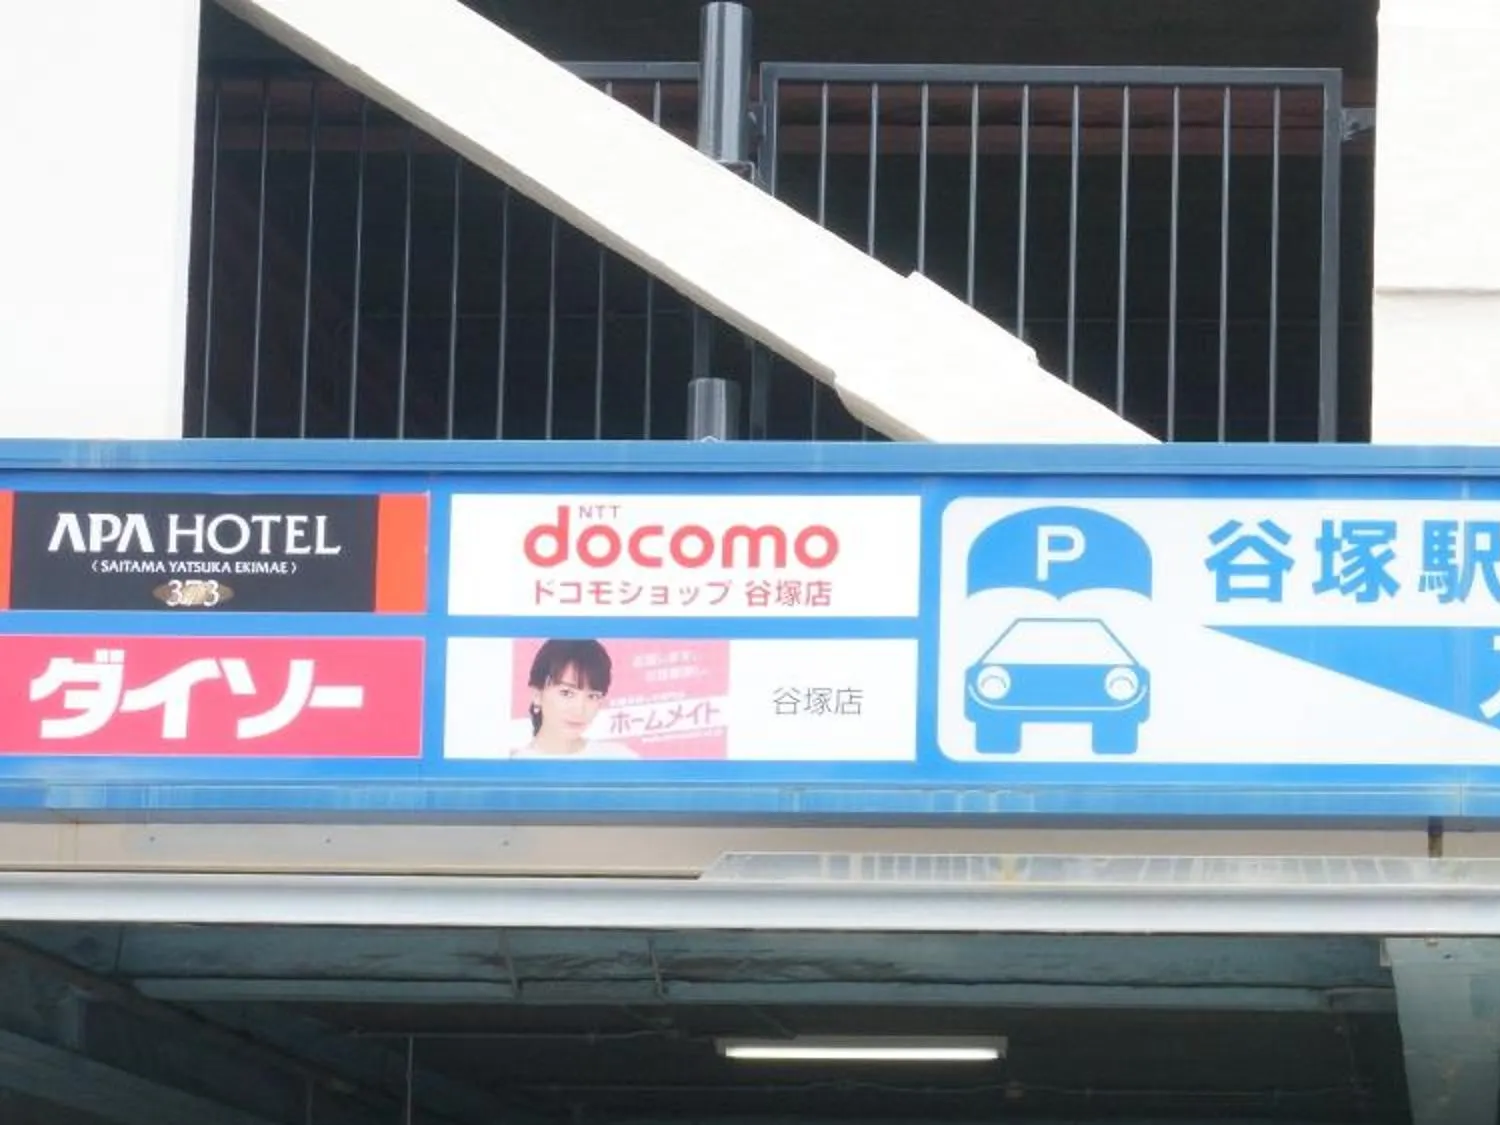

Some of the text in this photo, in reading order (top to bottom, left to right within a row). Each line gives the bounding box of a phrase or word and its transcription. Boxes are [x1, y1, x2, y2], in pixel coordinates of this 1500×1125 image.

[579, 505, 621, 519] NTT
[47, 513, 341, 555] APA HOTEL
[523, 505, 840, 568] docomo
[170, 560, 231, 575] YATSUKA
[1036, 524, 1086, 582] P
[534, 579, 832, 607] ドコモショップ 谷塚店
[30, 650, 364, 740] ダイソー
[773, 686, 864, 716] 谷塚店
[610, 700, 720, 734] ホームメイト
